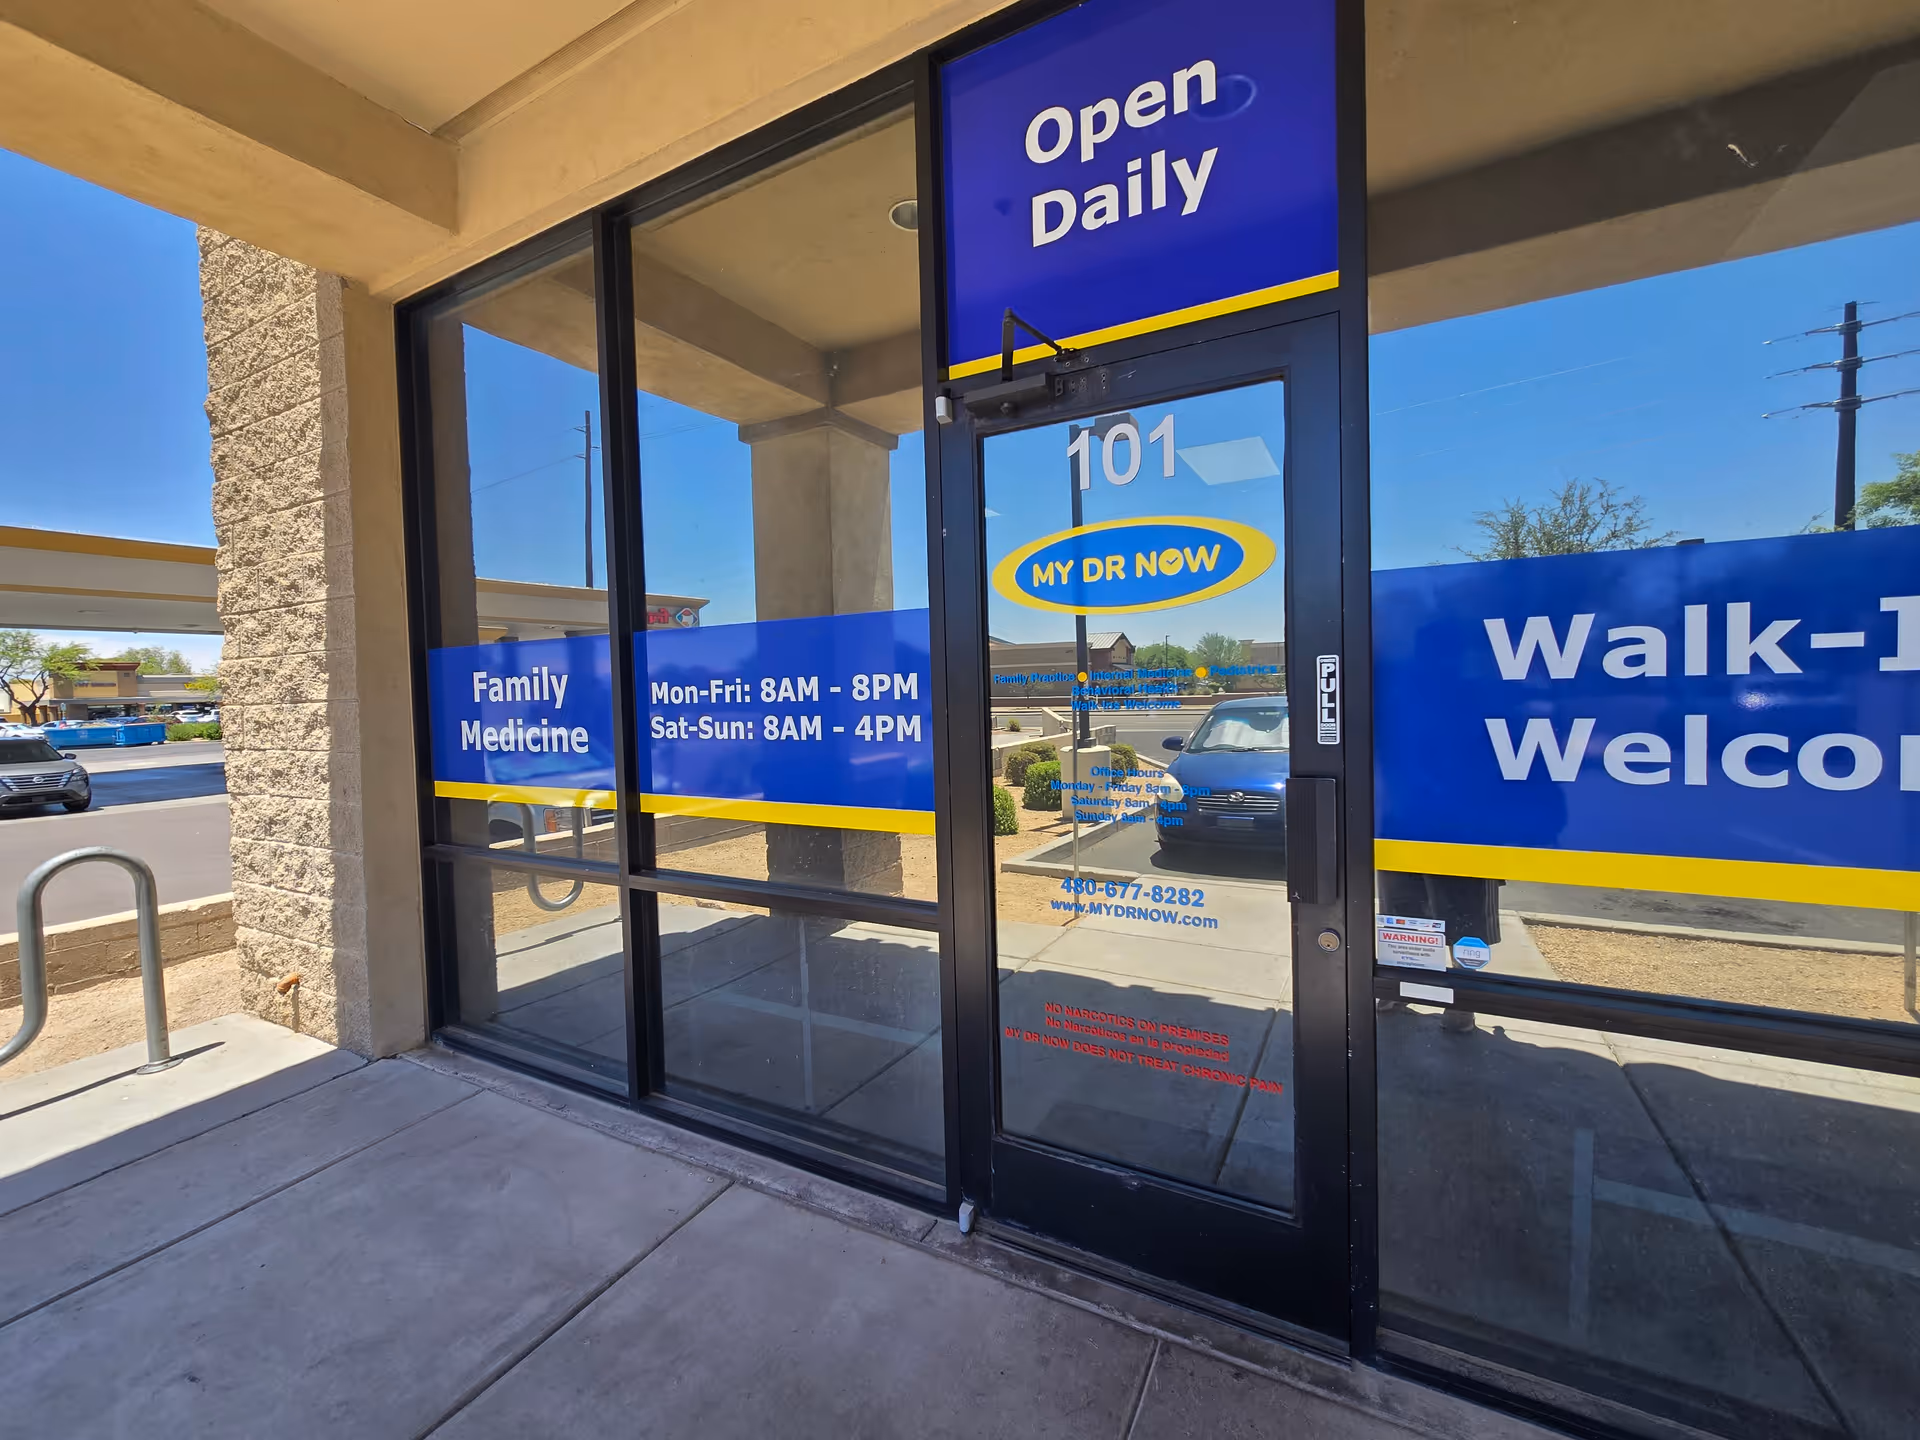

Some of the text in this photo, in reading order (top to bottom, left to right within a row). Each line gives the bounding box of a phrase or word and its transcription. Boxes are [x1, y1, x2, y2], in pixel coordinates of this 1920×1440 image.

[1025, 59, 1217, 163] Open
[1032, 147, 1218, 247] Daily
[1067, 413, 1175, 491] 101
[1032, 544, 1221, 587] MY DR NOW
[473, 666, 568, 709] Family
[651, 678, 751, 704] Mon-Fri:
[760, 676, 819, 702] 8AM
[851, 672, 918, 701] 8PM
[993, 664, 1278, 685] Family Practice Internal Medicine Pediatrics
[1071, 682, 1179, 696] Behavioral Health
[1071, 699, 1182, 711] Walk Ins Welcome
[1320, 663, 1336, 722] PULL
[461, 718, 589, 754] Medicine
[651, 714, 922, 742] Sat-Sun: 8AM - 4PM
[1484, 714, 1920, 791] Welco
[1090, 766, 1165, 778] Office Hours
[1050, 780, 1095, 793] Monday
[1105, 783, 1143, 795] Friday
[1145, 783, 1171, 794] 8am
[1182, 784, 1212, 798] 8pm
[1071, 795, 1121, 809] Saturday
[1124, 798, 1150, 808] 8am
[1160, 800, 1188, 813] 4pm
[1075, 810, 1117, 824] Sunday
[1121, 813, 1146, 823] 8am
[1156, 815, 1184, 828] 4pm
[1061, 877, 1205, 907] 480-677-8282
[1050, 900, 1219, 929] www.MYDRNOW.com
[1382, 932, 1439, 945] WARNING!
[1463, 948, 1481, 958] ring
[1045, 1002, 1229, 1046] NO NARCOTICS ON PREMISES
[1045, 1016, 1061, 1028] No
[1129, 1035, 1144, 1045] en
[1147, 1036, 1159, 1048] la
[1162, 1041, 1230, 1062] propiedad
[1005, 1027, 1284, 1095] MY DR NOW DOES NOT TREAT CHRONIC PAIN
